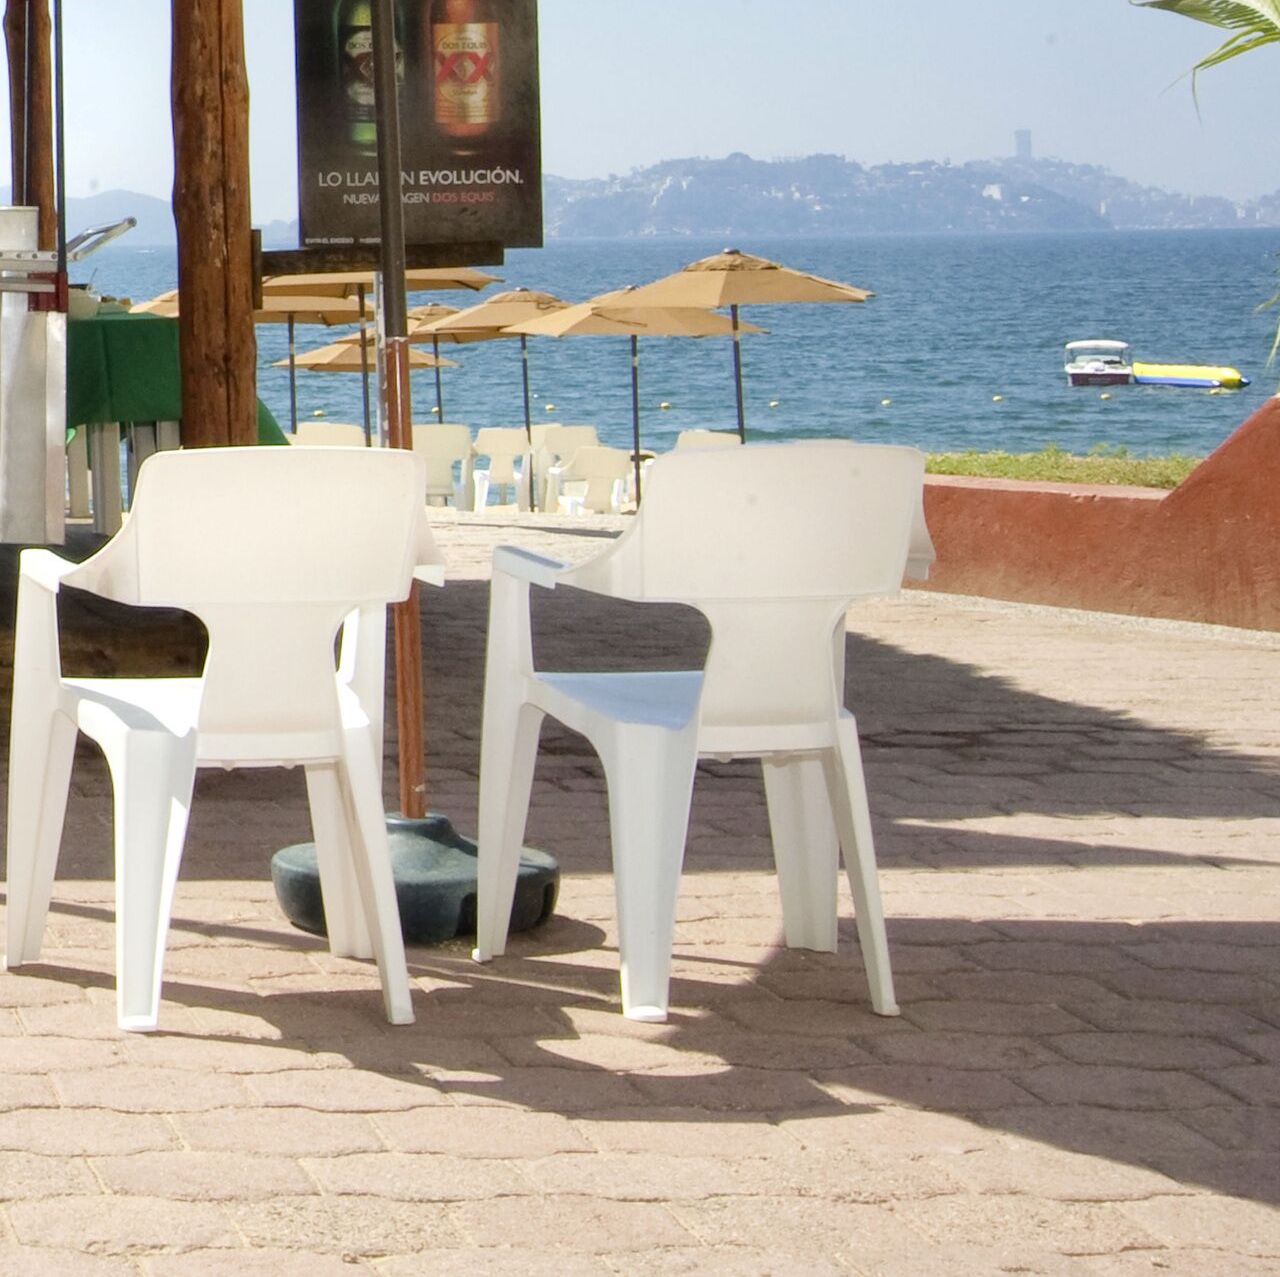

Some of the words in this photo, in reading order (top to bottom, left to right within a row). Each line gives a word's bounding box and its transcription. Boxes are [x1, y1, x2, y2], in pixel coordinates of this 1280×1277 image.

[318, 171, 342, 187] LO
[419, 166, 524, 185] EVOLUCIÓN.
[432, 191, 457, 203] DOS
